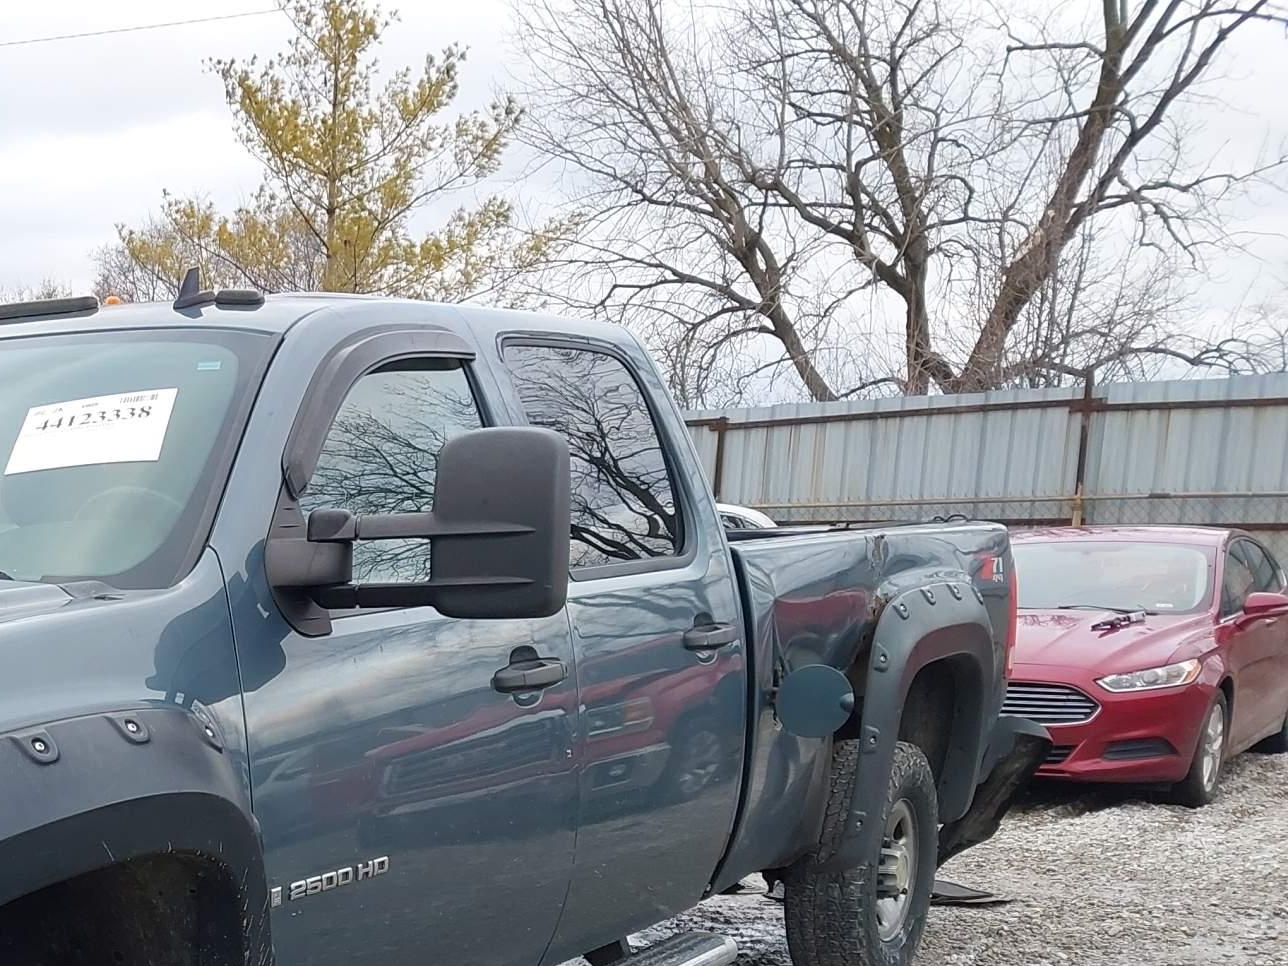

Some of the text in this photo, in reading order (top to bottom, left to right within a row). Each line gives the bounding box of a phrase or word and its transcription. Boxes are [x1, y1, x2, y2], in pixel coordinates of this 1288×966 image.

[35, 405, 153, 431] 44123338
[289, 866, 353, 901] 2500
[357, 855, 389, 881] HD
